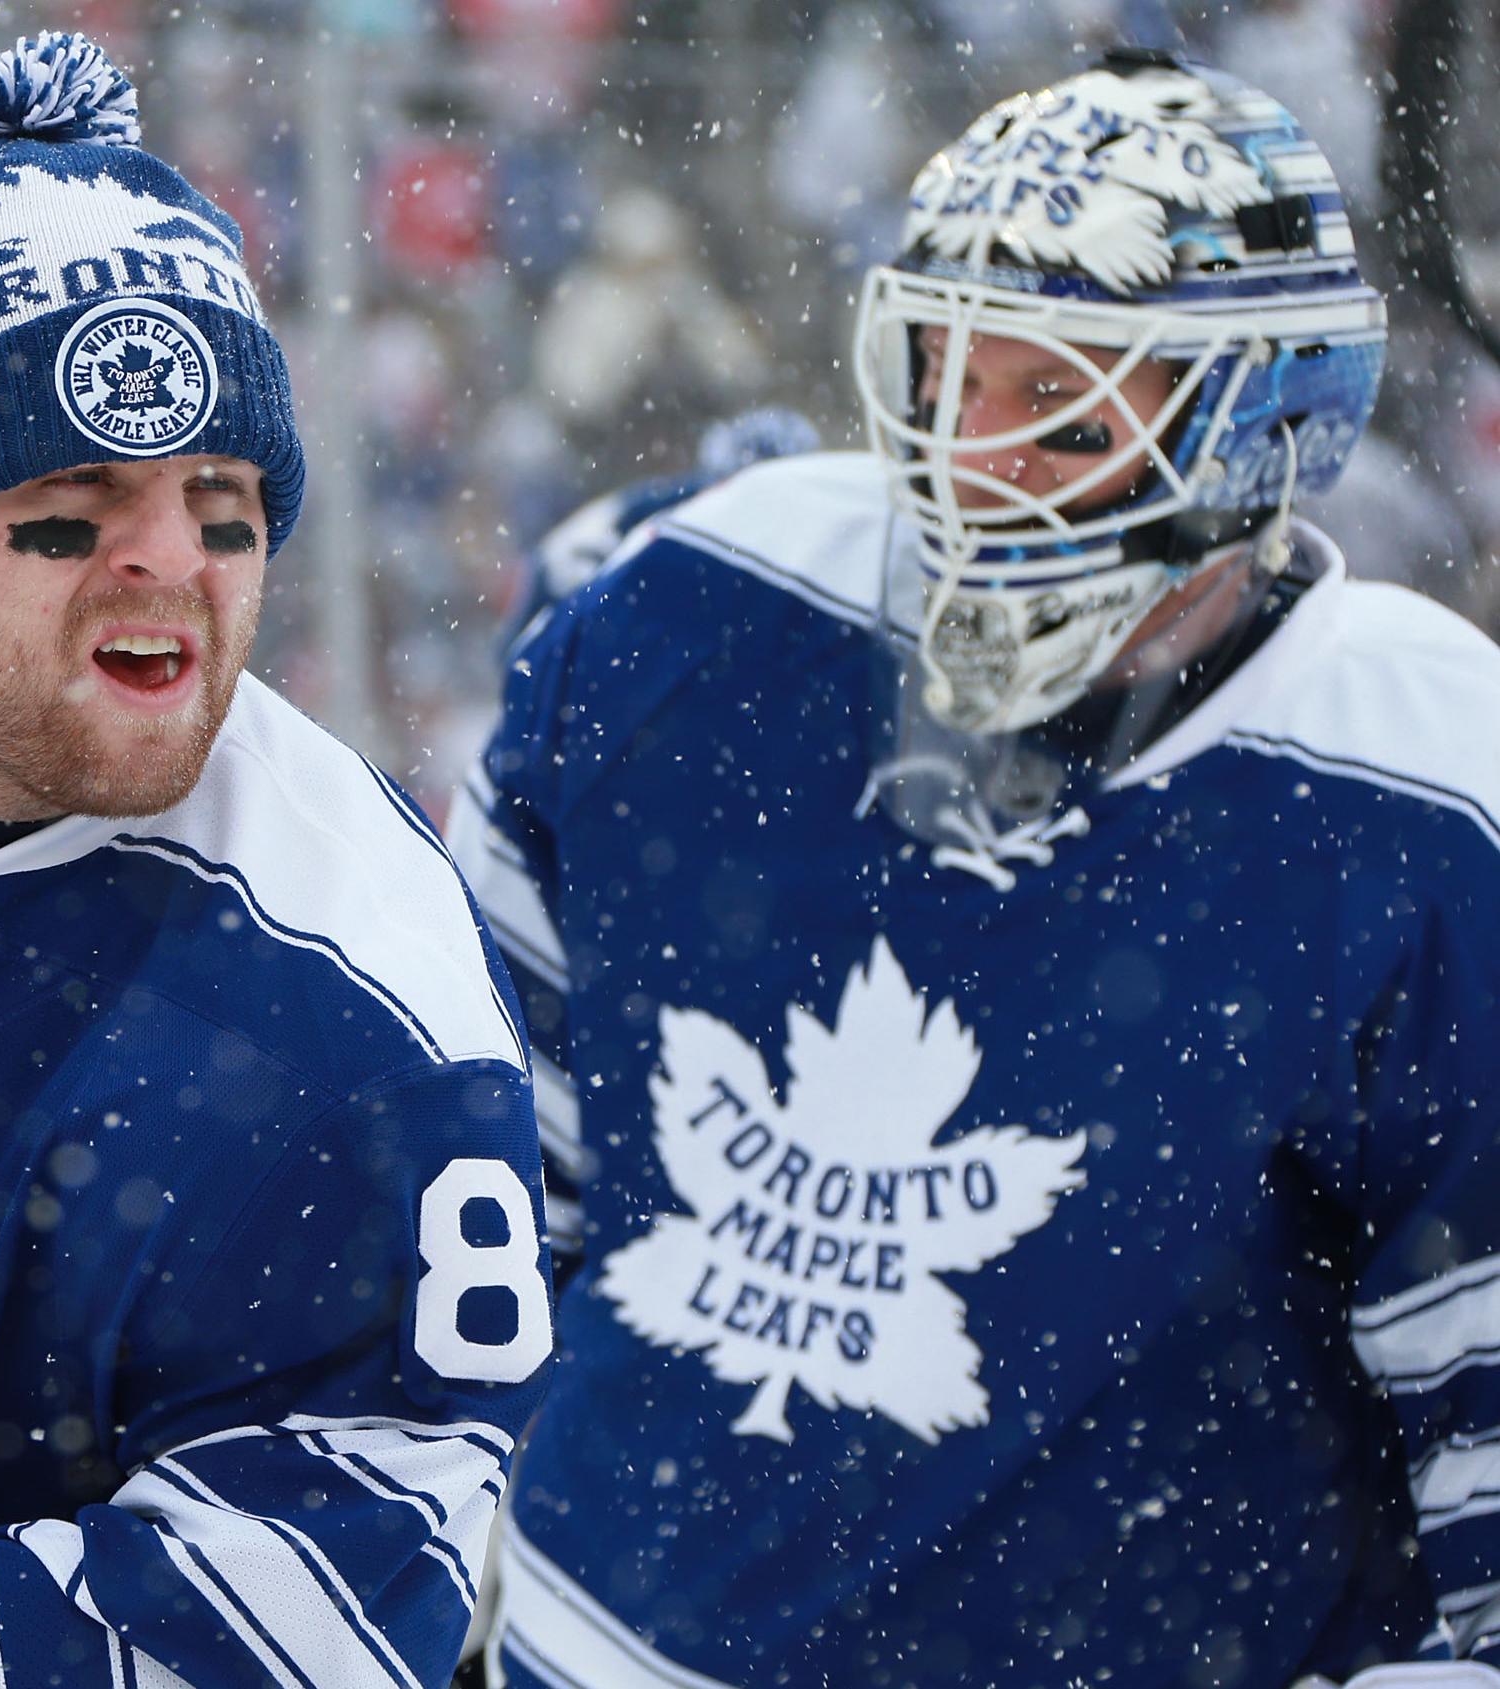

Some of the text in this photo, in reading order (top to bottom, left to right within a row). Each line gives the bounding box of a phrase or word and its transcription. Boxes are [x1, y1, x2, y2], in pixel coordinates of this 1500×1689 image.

[73, 318, 201, 397] NHL WINTER CLASSIC
[107, 364, 164, 383] TORONTO
[119, 380, 156, 393] MAPLE
[86, 398, 197, 440] MAPLE LEAFS
[120, 392, 155, 404] LEAFS
[688, 1077, 999, 1222] TORONTO
[414, 1158, 553, 1383] 8
[708, 1198, 907, 1293] MAPLE
[687, 1262, 876, 1364] LEAFS
